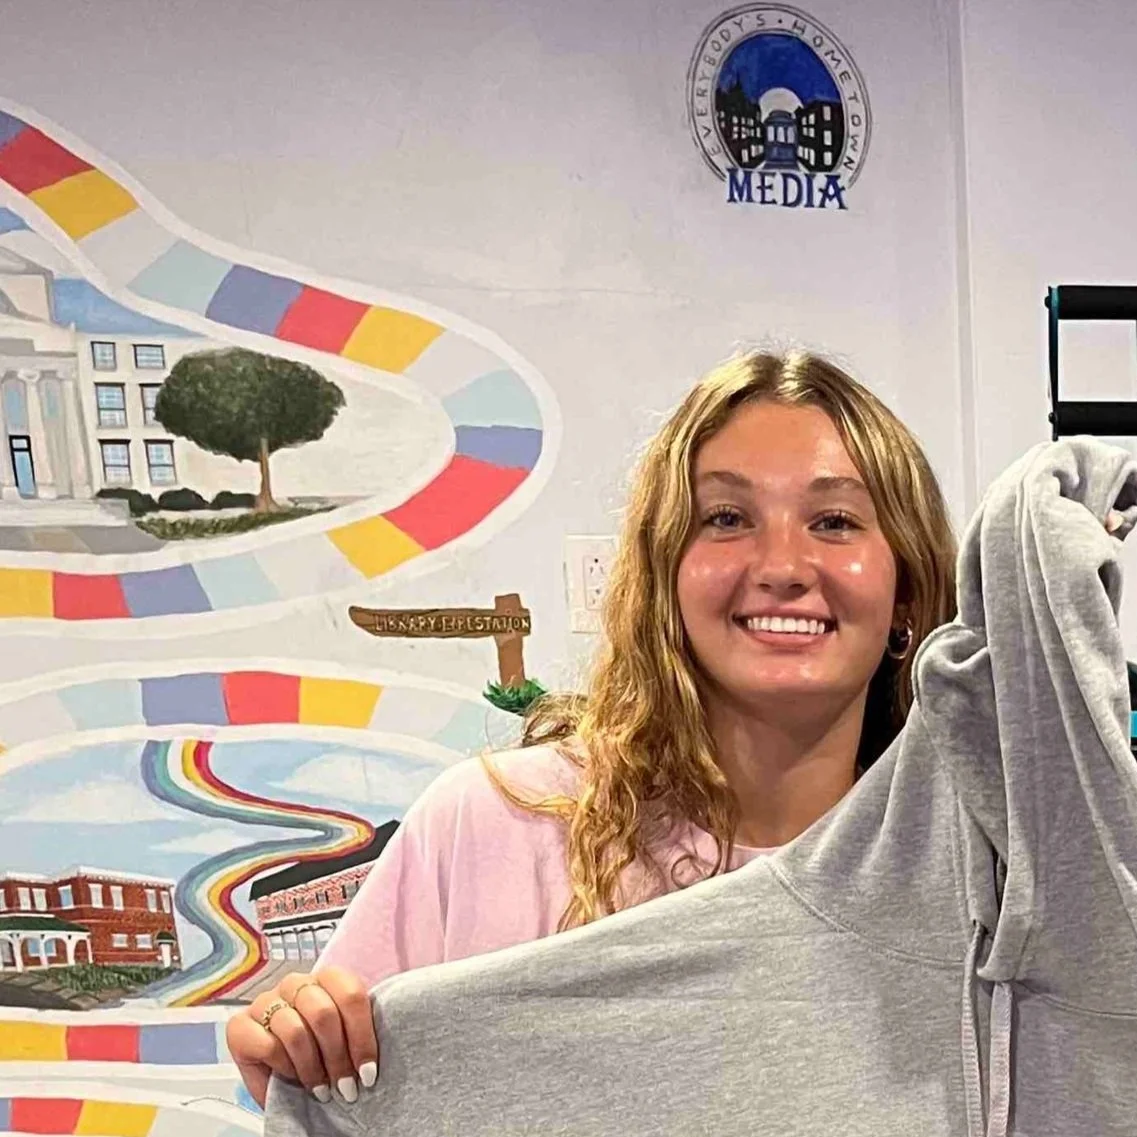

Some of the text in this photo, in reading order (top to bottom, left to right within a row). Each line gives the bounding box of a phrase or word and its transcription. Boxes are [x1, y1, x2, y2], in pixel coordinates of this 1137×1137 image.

[696, 13, 862, 172] EVERYBODY'S HOMETOWN
[725, 167, 848, 210] MEDIA
